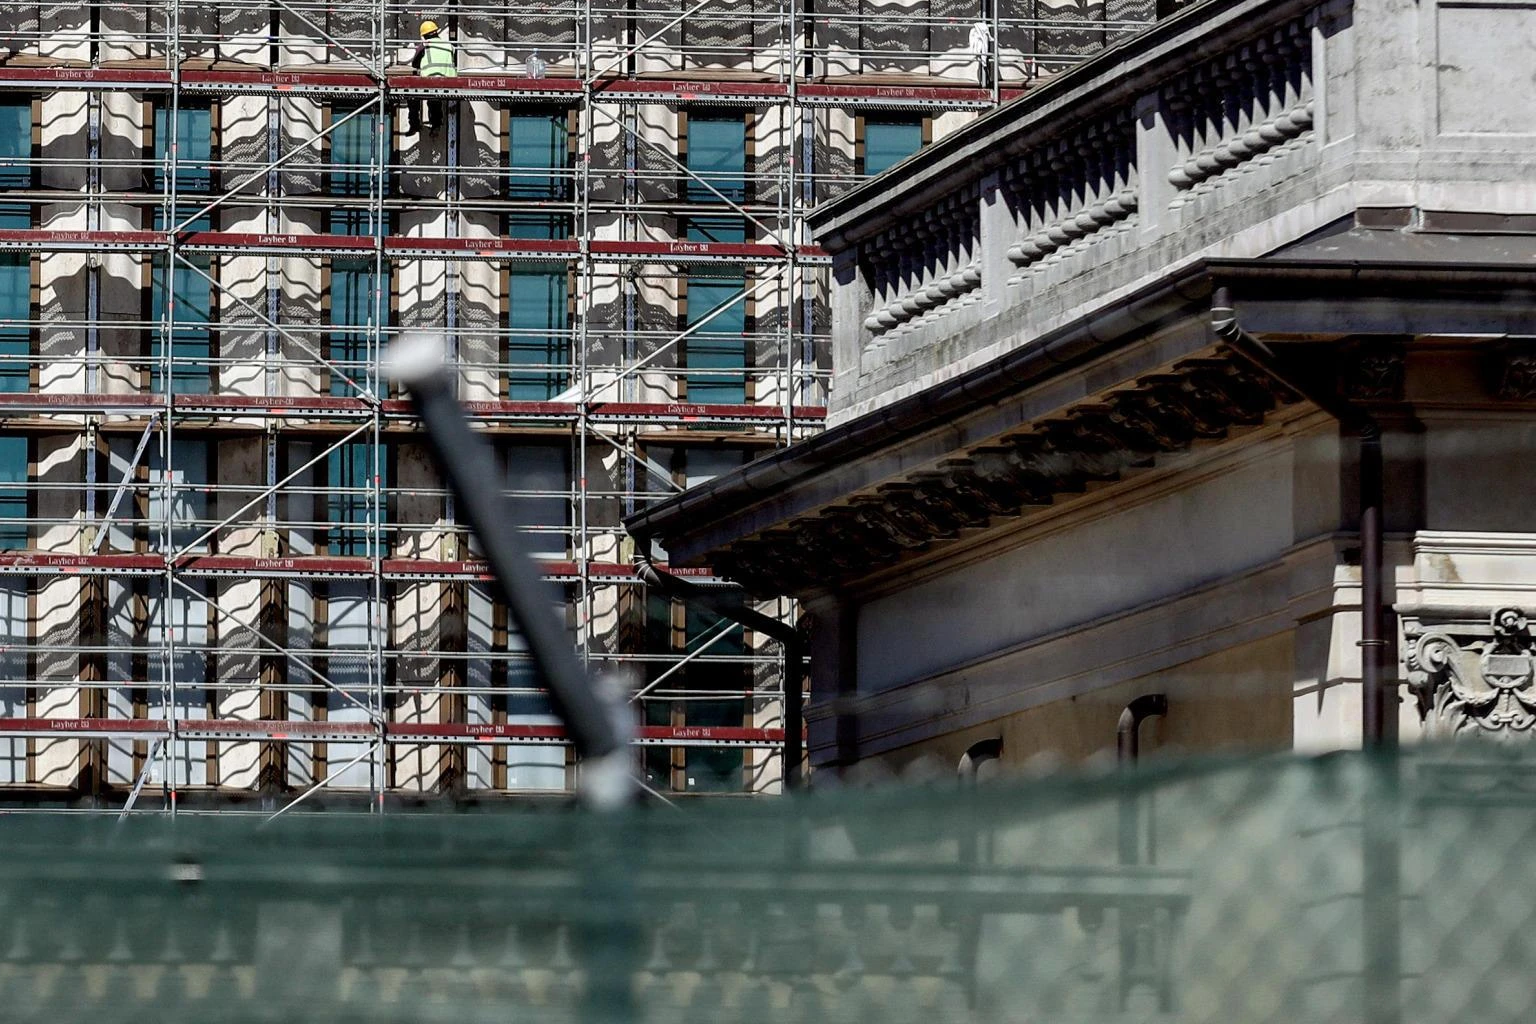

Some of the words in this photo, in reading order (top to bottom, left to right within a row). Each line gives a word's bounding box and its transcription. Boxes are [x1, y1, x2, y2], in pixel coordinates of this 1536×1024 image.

[55, 70, 83, 80] Layher
[468, 79, 496, 88] Layher
[259, 235, 287, 245] Layher
[465, 240, 493, 249] Layher
[670, 243, 698, 253] Layher
[48, 557, 76, 566] Layher
[255, 559, 283, 569] Layher
[51, 720, 79, 730] Layher
[466, 725, 494, 735] Layher
[673, 728, 701, 738] Layher
